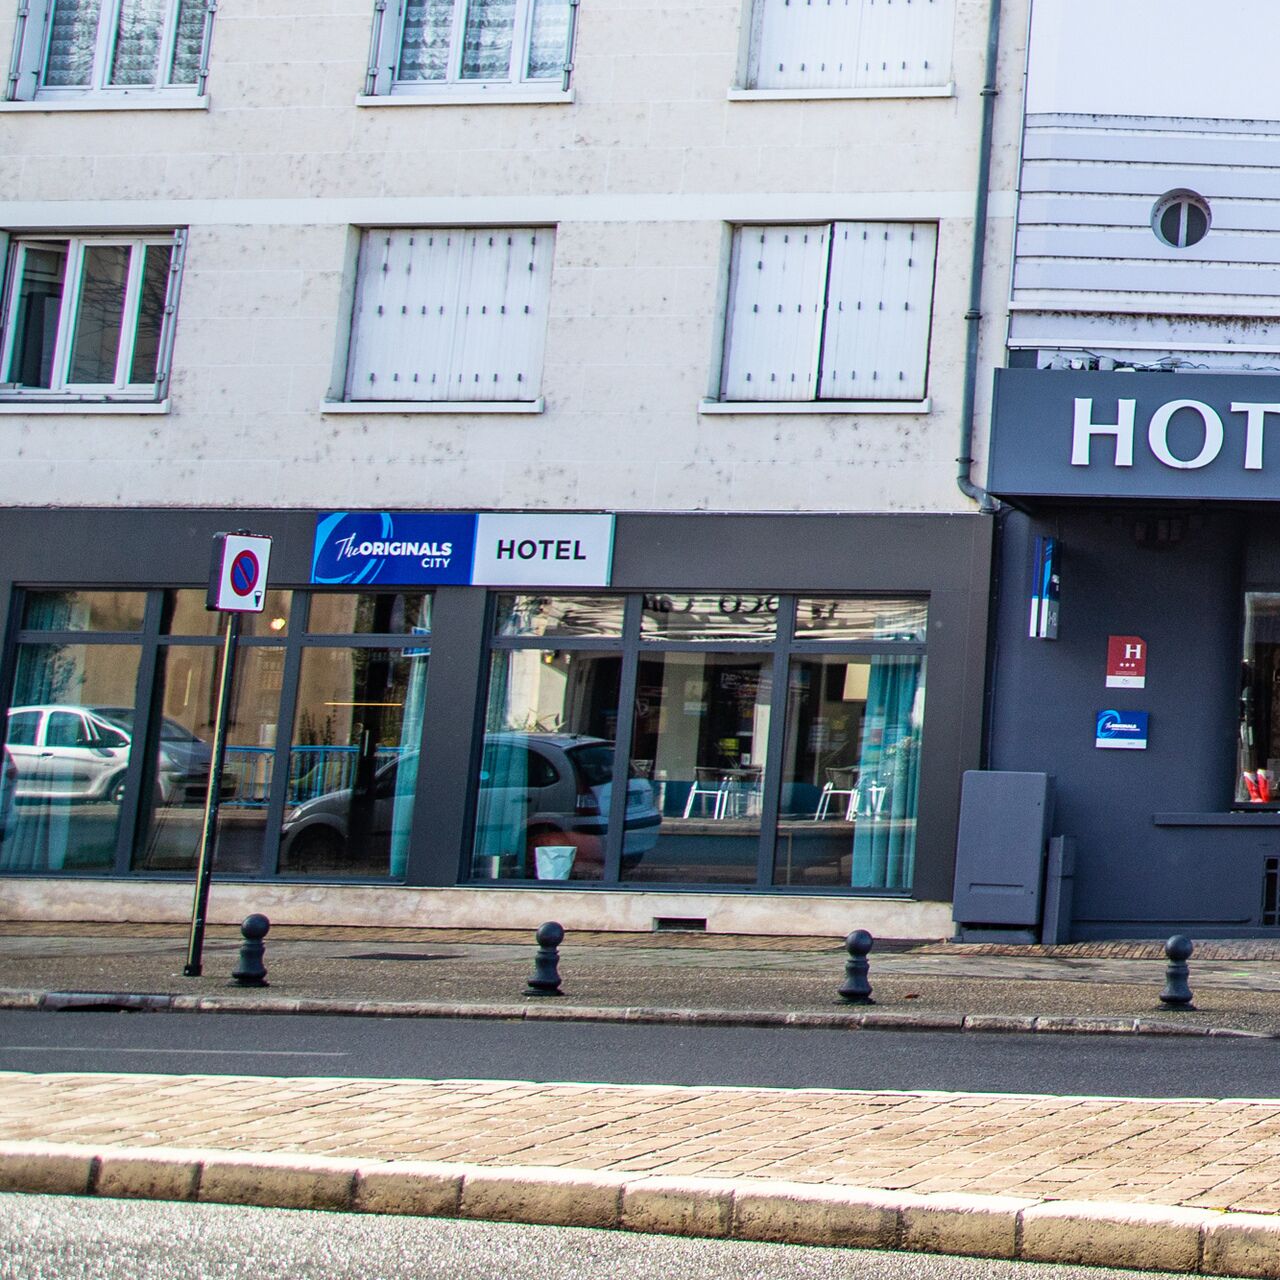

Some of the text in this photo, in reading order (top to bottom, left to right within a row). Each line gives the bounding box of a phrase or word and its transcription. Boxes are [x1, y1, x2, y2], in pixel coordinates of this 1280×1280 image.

[359, 541, 452, 557] ORIGINALS
[496, 539, 586, 561] HOTEL
[422, 557, 451, 569] CITY
[1124, 643, 1142, 660] H
